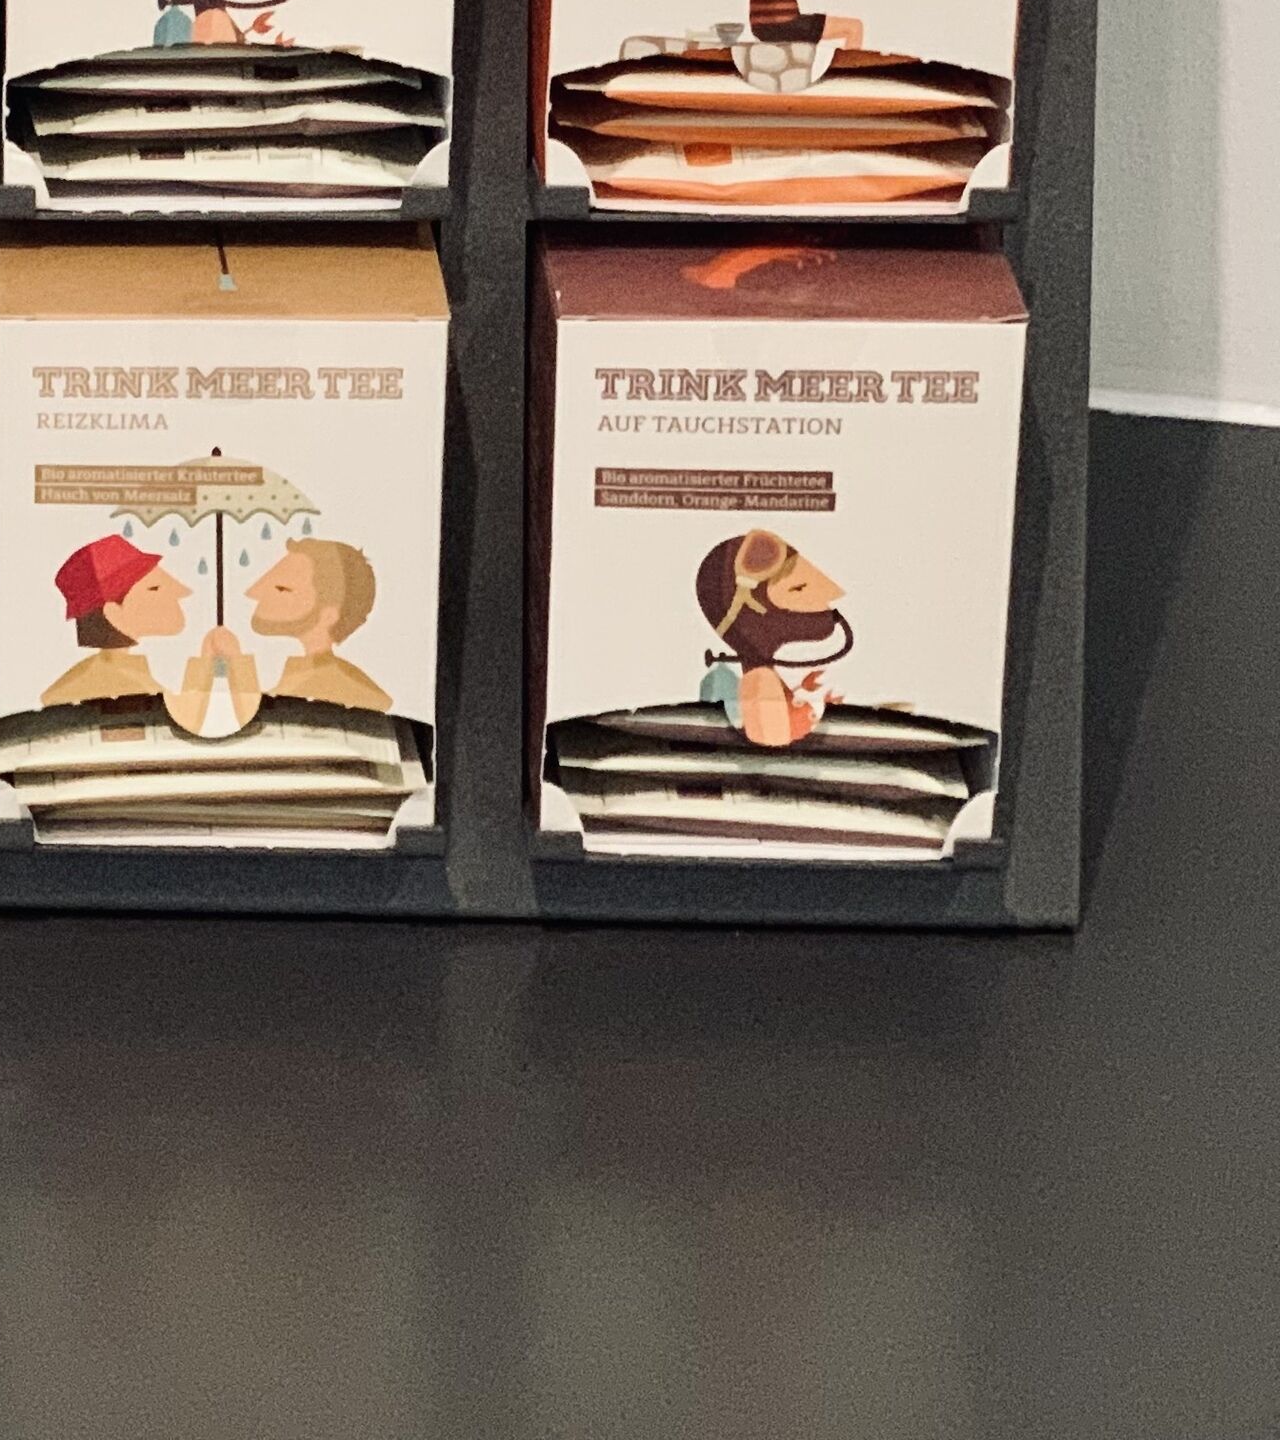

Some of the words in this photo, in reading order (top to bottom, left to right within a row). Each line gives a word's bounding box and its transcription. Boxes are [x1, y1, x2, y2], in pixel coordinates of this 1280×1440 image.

[33, 366, 179, 399] TRINK
[185, 367, 315, 400] MEER
[318, 367, 404, 400] TEE
[595, 368, 747, 402] TRINK
[754, 369, 888, 403] MEER
[890, 370, 980, 405] TEE
[36, 412, 169, 431] REIZKLIMA
[597, 415, 646, 433] AUF
[653, 416, 843, 436] TAUCHSTATION
[40, 469, 65, 482] Bio
[177, 469, 258, 483] Kräutertee
[602, 472, 626, 485] Bio
[629, 472, 740, 487] aromatisierter
[743, 473, 827, 489] Früchtetee
[40, 488, 89, 502] Hauch
[92, 491, 121, 502] von
[125, 489, 192, 503] Meersalz
